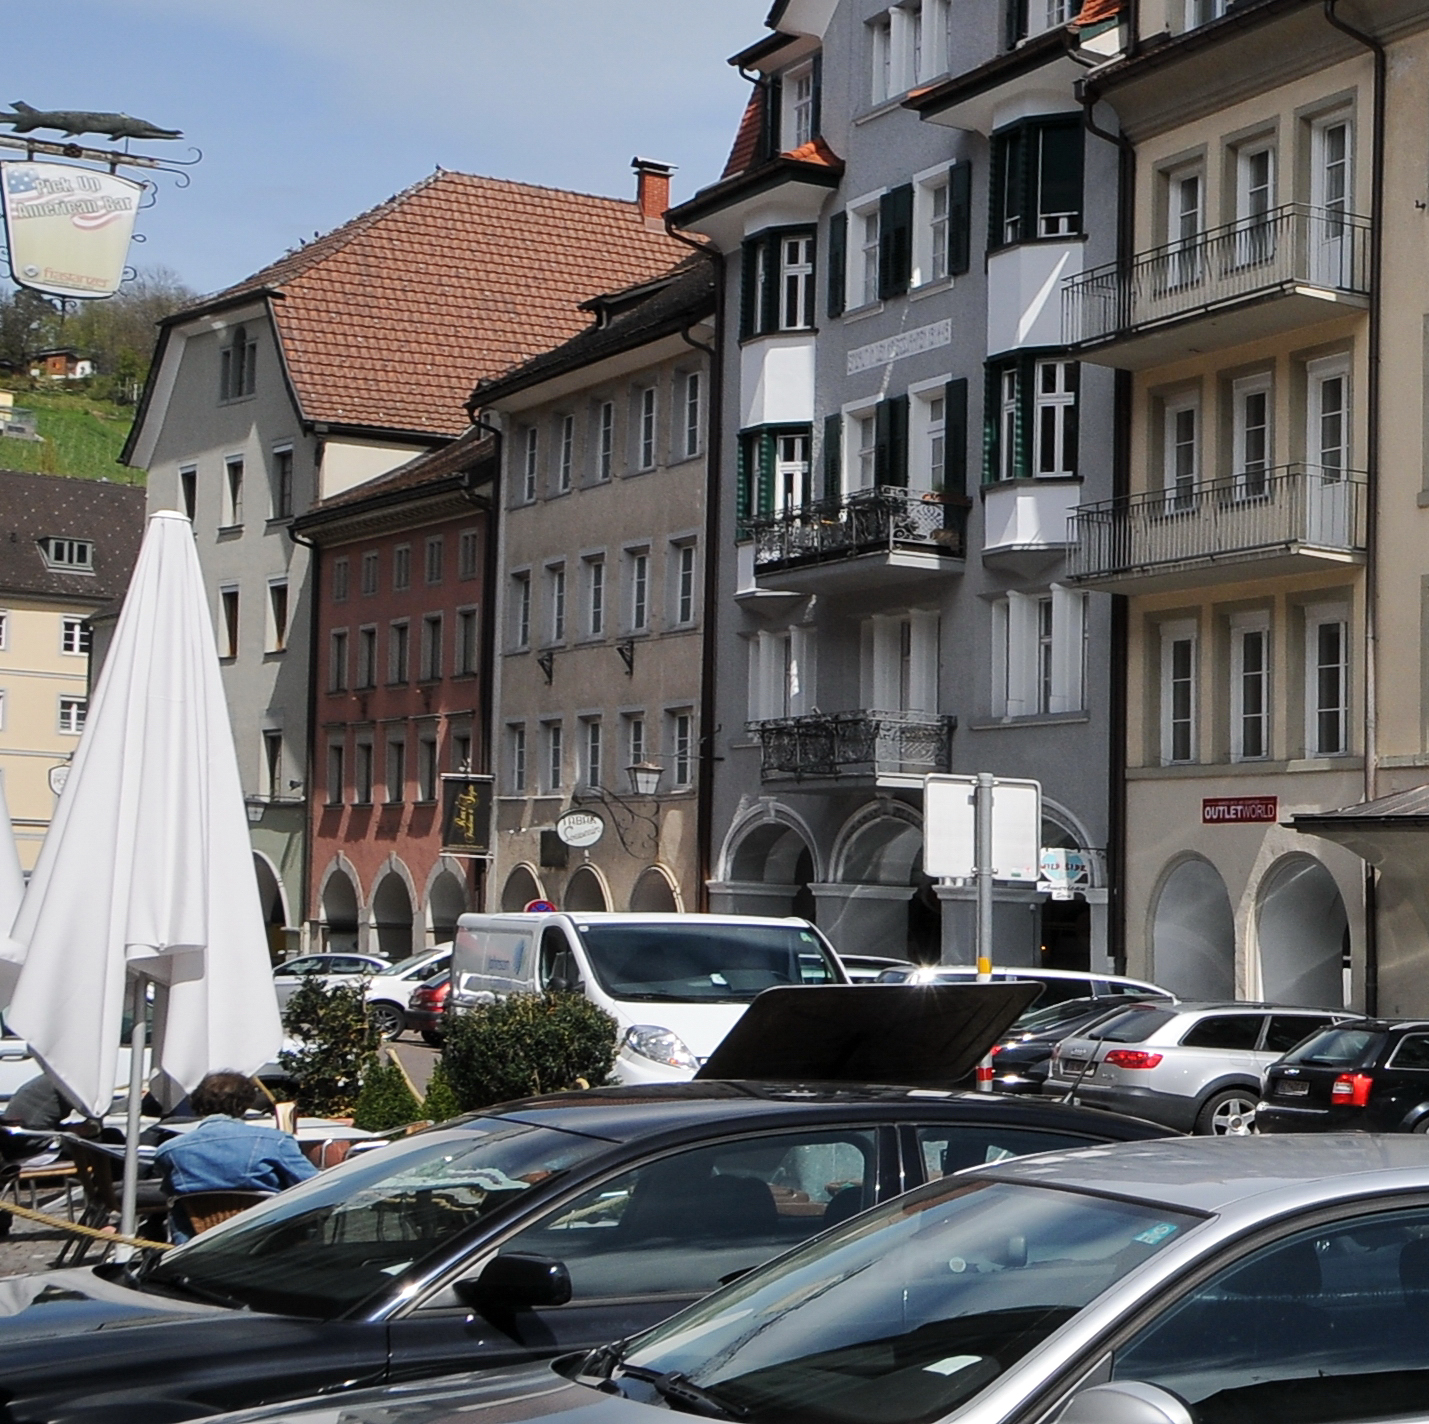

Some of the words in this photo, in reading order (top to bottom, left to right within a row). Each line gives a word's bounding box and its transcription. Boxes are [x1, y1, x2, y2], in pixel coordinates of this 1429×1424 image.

[35, 177, 74, 195] Pick
[77, 175, 101, 193] Up
[17, 199, 99, 218] American
[101, 196, 133, 212] Bar
